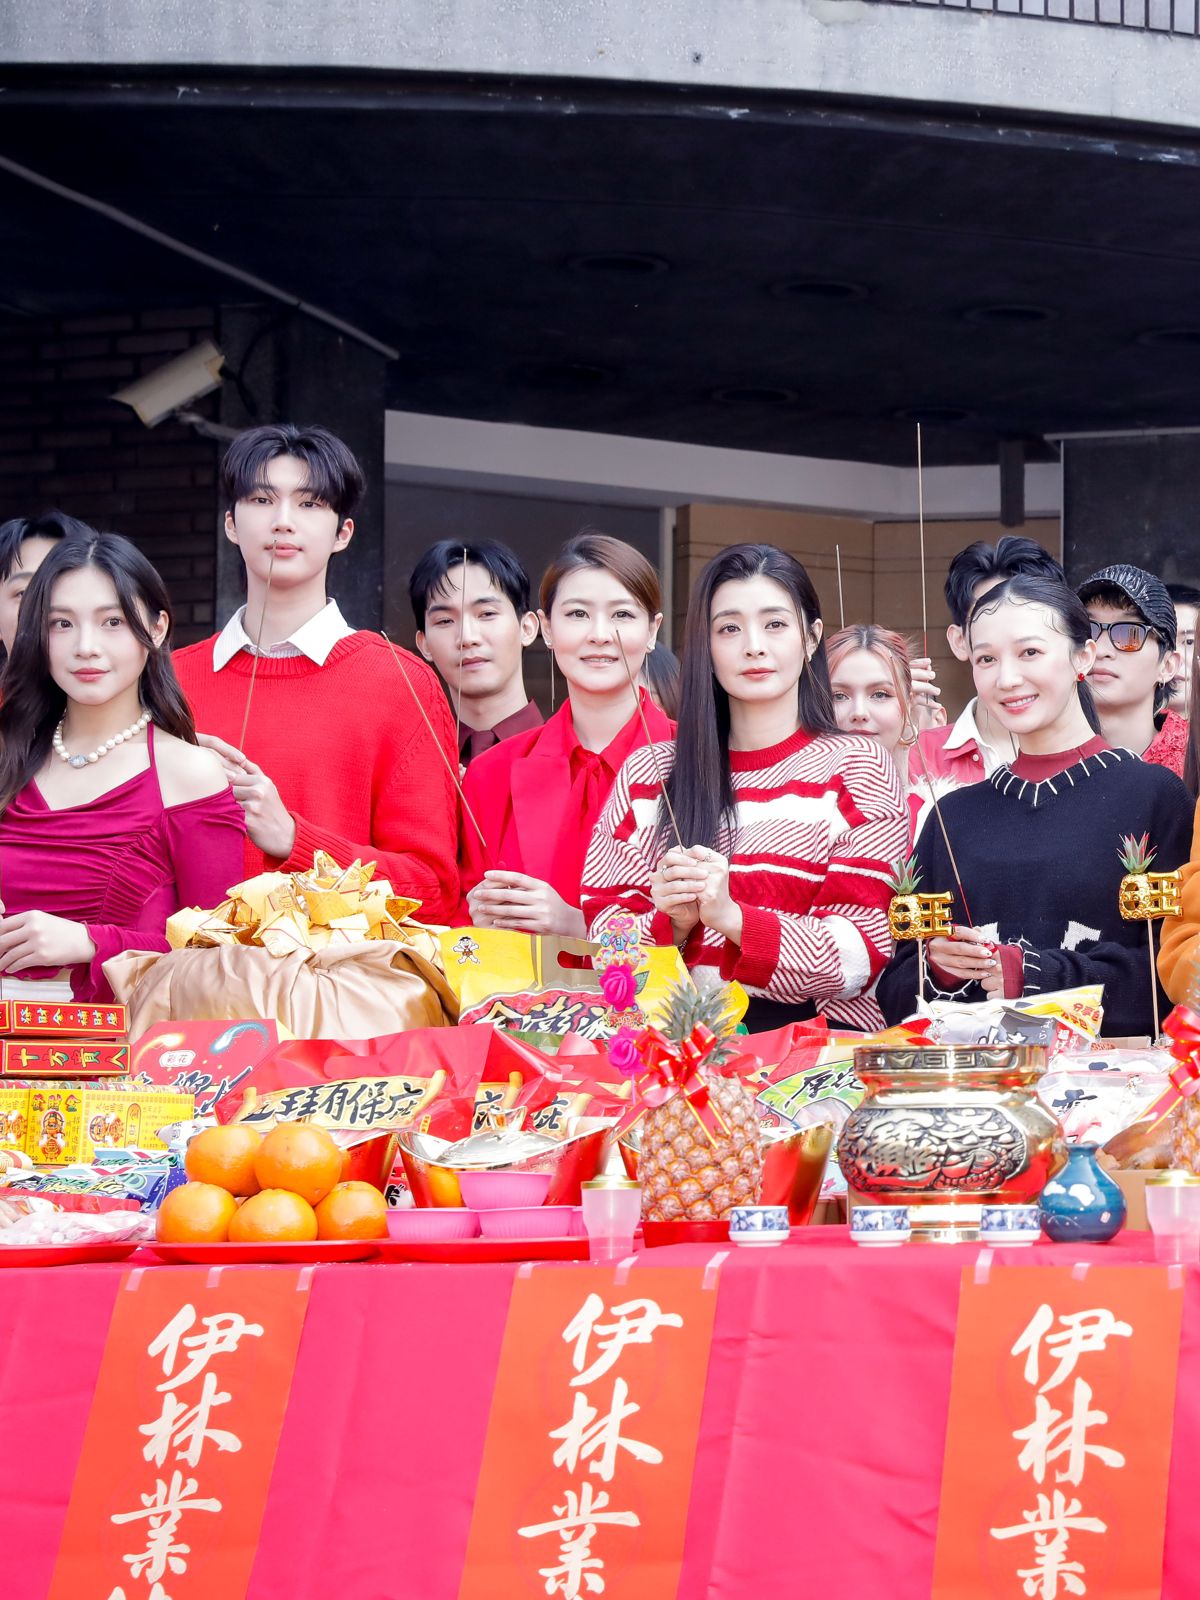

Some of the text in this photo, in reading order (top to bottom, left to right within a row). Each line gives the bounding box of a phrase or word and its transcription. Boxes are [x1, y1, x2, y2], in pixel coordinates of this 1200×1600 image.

[110, 1303, 264, 1600] 伊林業
[518, 1294, 683, 1596] 伊林業
[982, 1304, 1133, 1598] 伊林業
